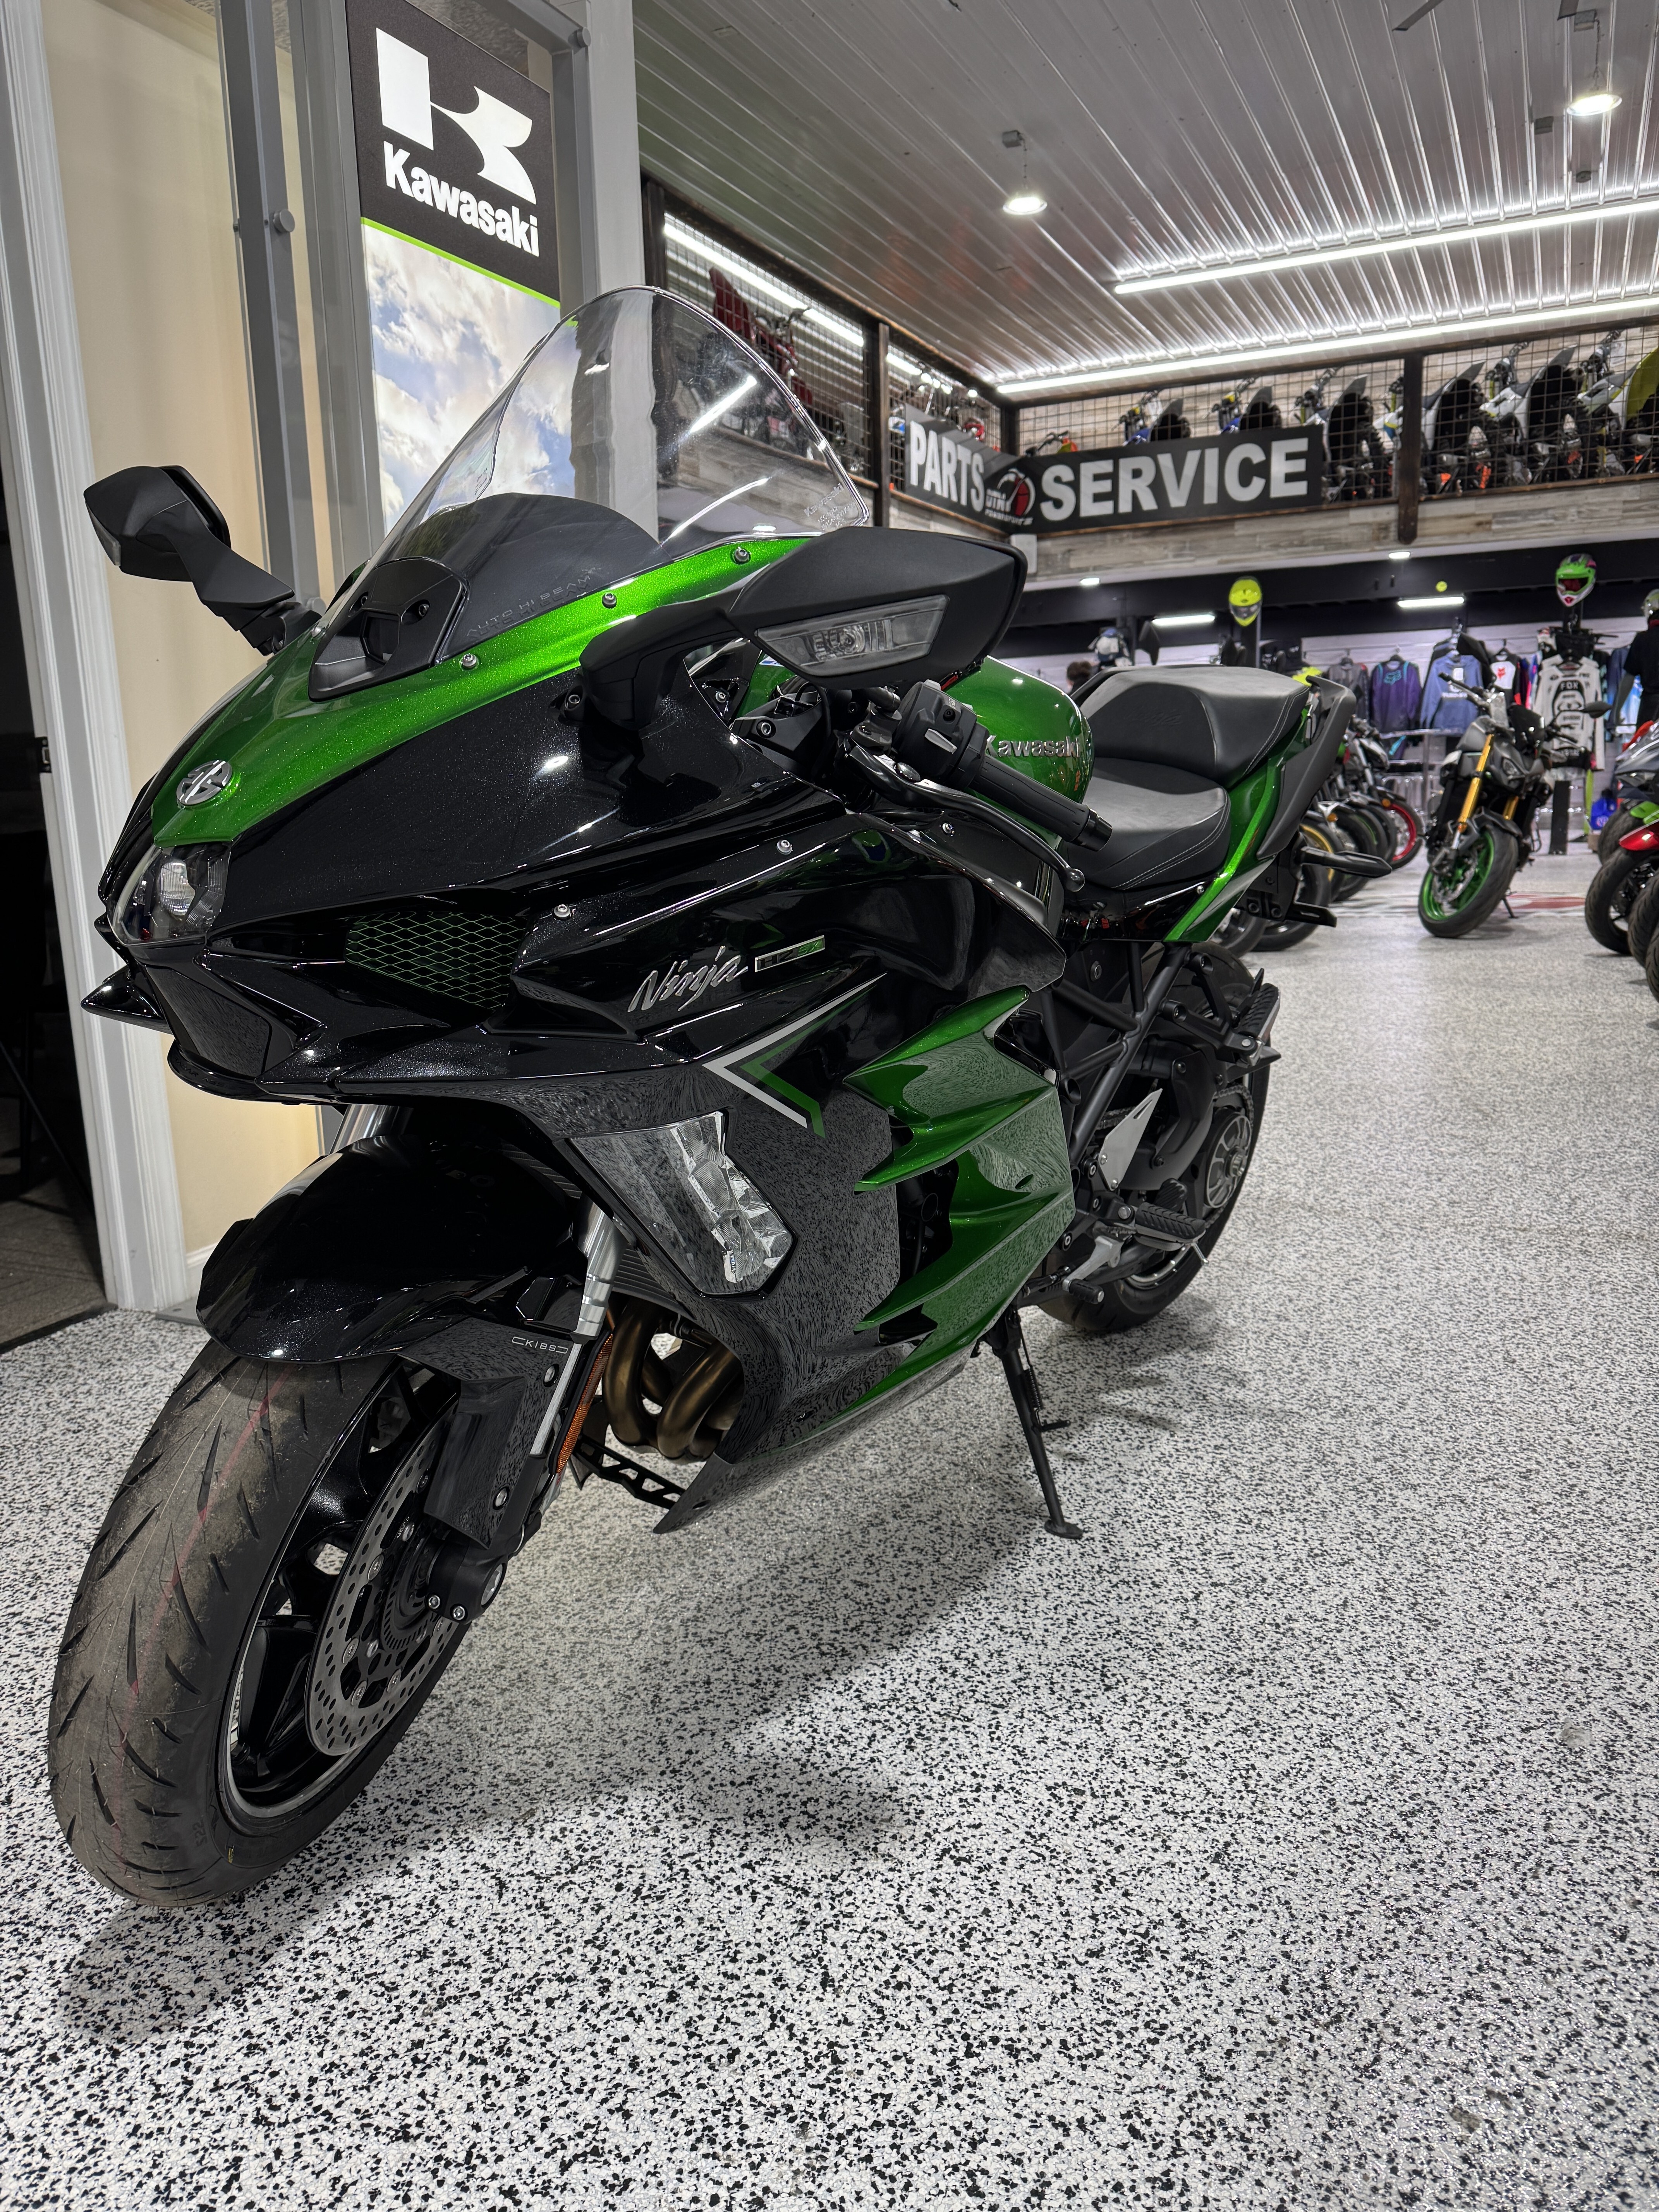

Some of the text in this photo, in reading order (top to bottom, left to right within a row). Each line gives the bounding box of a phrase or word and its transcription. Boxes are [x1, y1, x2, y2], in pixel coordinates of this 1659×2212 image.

[383, 141, 539, 257] Kawasaki
[910, 419, 1309, 522] PARTS SERVICE
[804, 483, 844, 517] Kawasaki
[467, 575, 591, 636] AUTO HI BEAM
[1560, 681, 1579, 690] FOX
[986, 735, 1080, 757] Kawasaki
[627, 945, 749, 1012] Ninja
[760, 949, 796, 969] H2
[192, 1818, 208, 1847] S22
